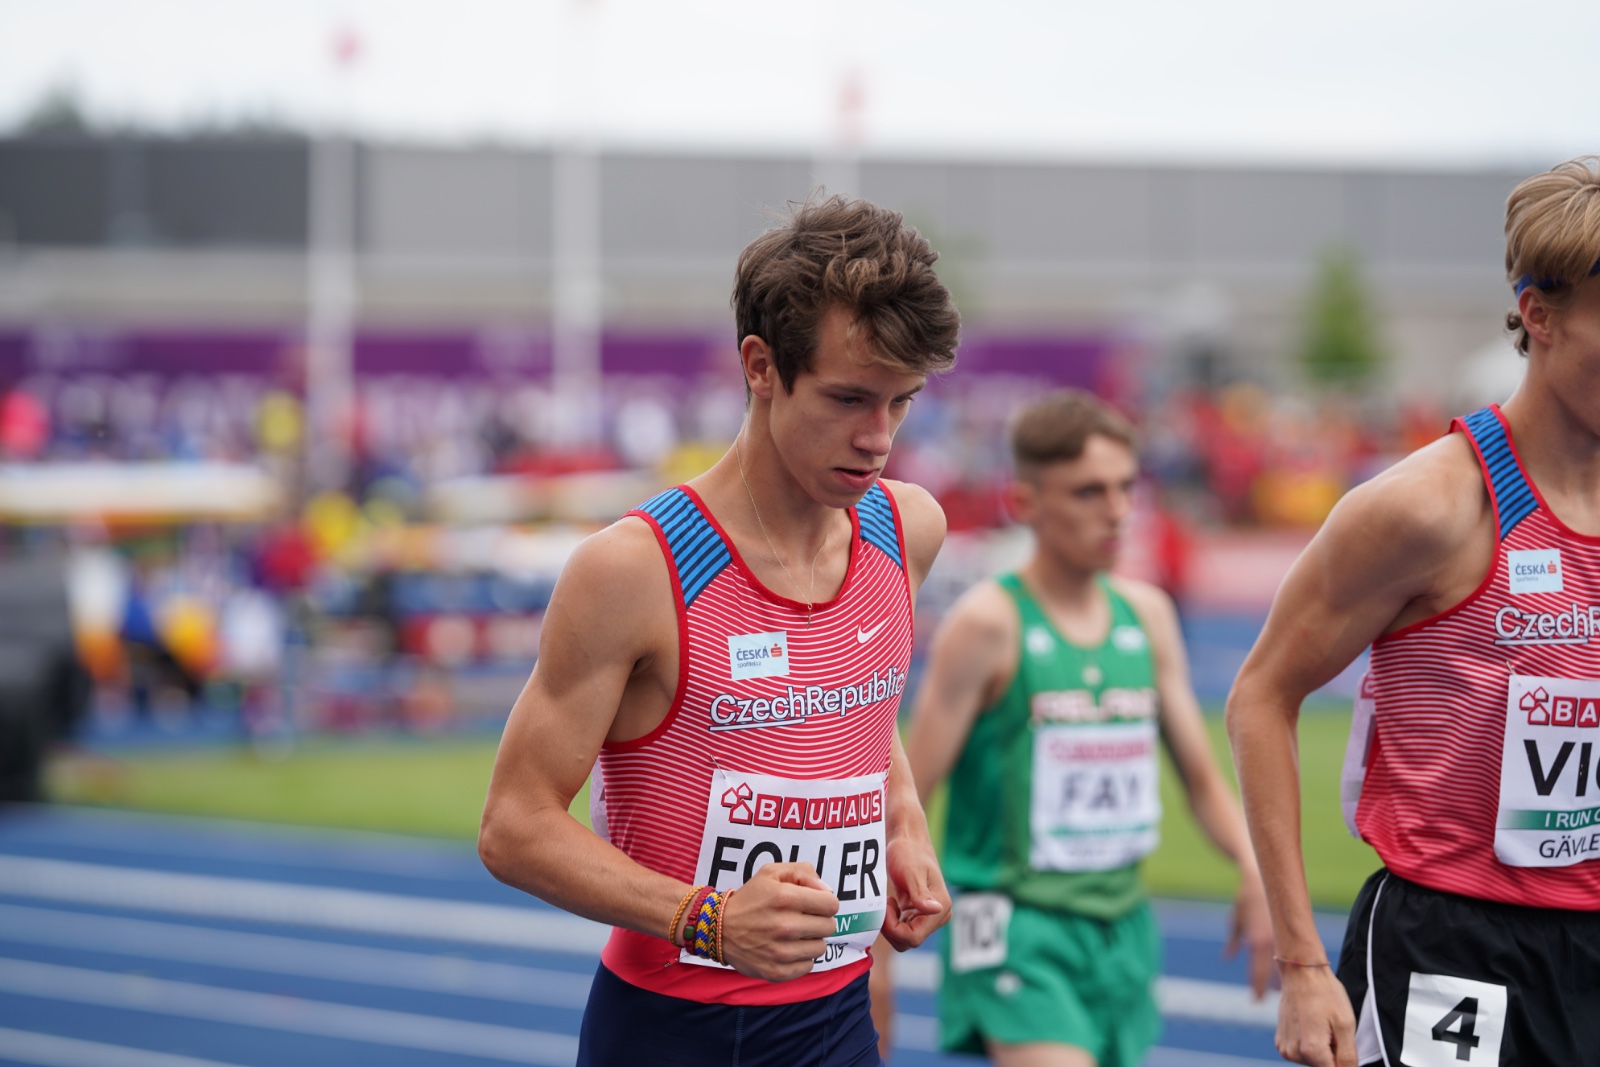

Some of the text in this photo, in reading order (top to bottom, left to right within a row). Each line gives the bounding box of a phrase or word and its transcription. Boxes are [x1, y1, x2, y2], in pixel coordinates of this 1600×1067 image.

[1515, 562, 1546, 575] ČESKÁ
[736, 646, 770, 661] ČESKÁ
[710, 666, 905, 724] CzechRepublic
[1523, 739, 1600, 797] VI
[757, 792, 881, 826] BAUHAUS
[1545, 812, 1551, 828] I
[1555, 809, 1592, 828] RUN
[1538, 833, 1600, 859] GÄVLE
[1431, 996, 1480, 1062] 4
